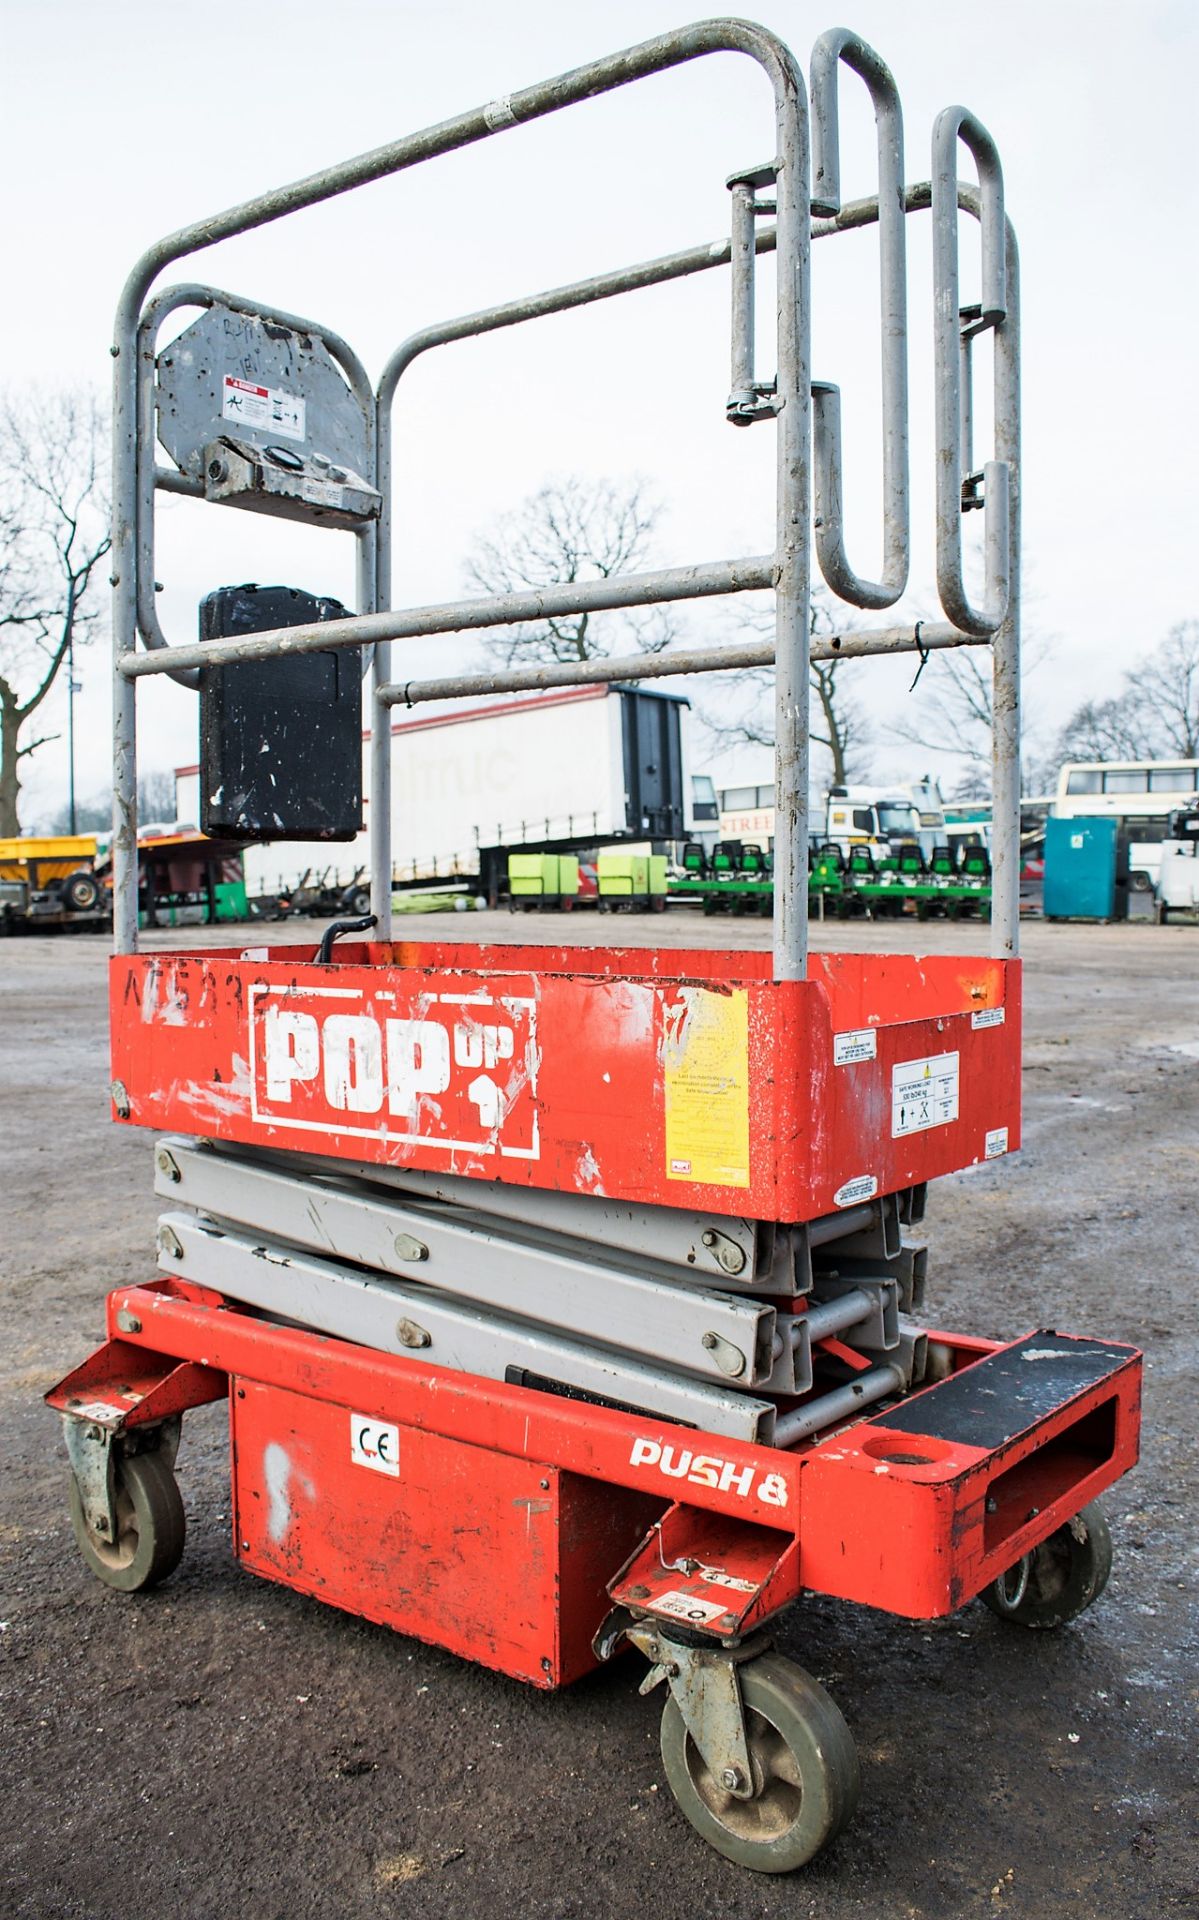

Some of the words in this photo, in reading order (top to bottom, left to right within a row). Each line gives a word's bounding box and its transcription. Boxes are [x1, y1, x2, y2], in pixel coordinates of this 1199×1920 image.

[266, 1010, 450, 1117] POP
[454, 1023, 514, 1069] UP
[359, 1427, 389, 1464] CE
[629, 1438, 756, 1497] PUSH
